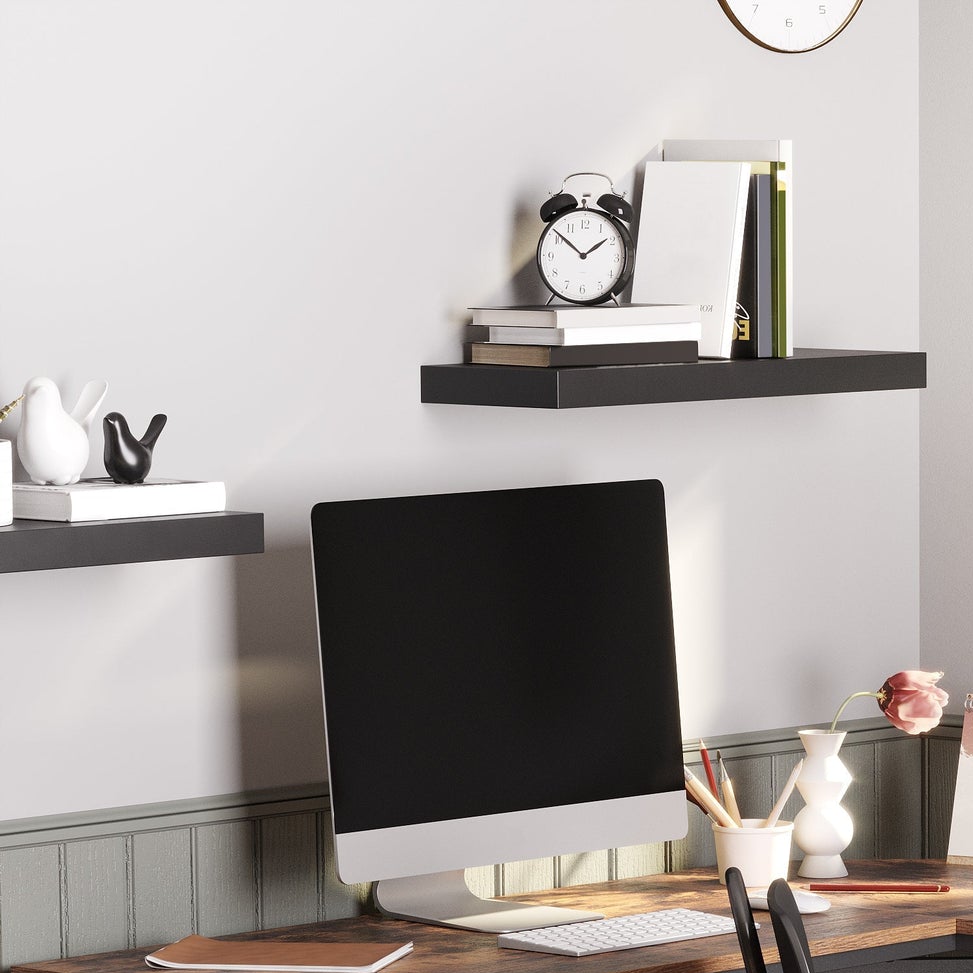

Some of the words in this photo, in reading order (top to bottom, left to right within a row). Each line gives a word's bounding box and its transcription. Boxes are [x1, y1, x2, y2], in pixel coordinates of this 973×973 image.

[752, 4, 759, 14] 7
[819, 5, 826, 14] 5
[785, 18, 793, 27] 6
[568, 224, 574, 233] 11
[581, 220, 590, 229] 12
[599, 224, 603, 233] 1
[555, 235, 563, 245] 10
[610, 237, 616, 246] 2
[548, 252, 554, 261] 9
[614, 255, 620, 263] 3
[552, 268, 558, 277] 8
[609, 270, 614, 278] 4
[565, 281, 570, 289] 7
[580, 285, 586, 294] 6
[598, 281, 604, 290] 5
